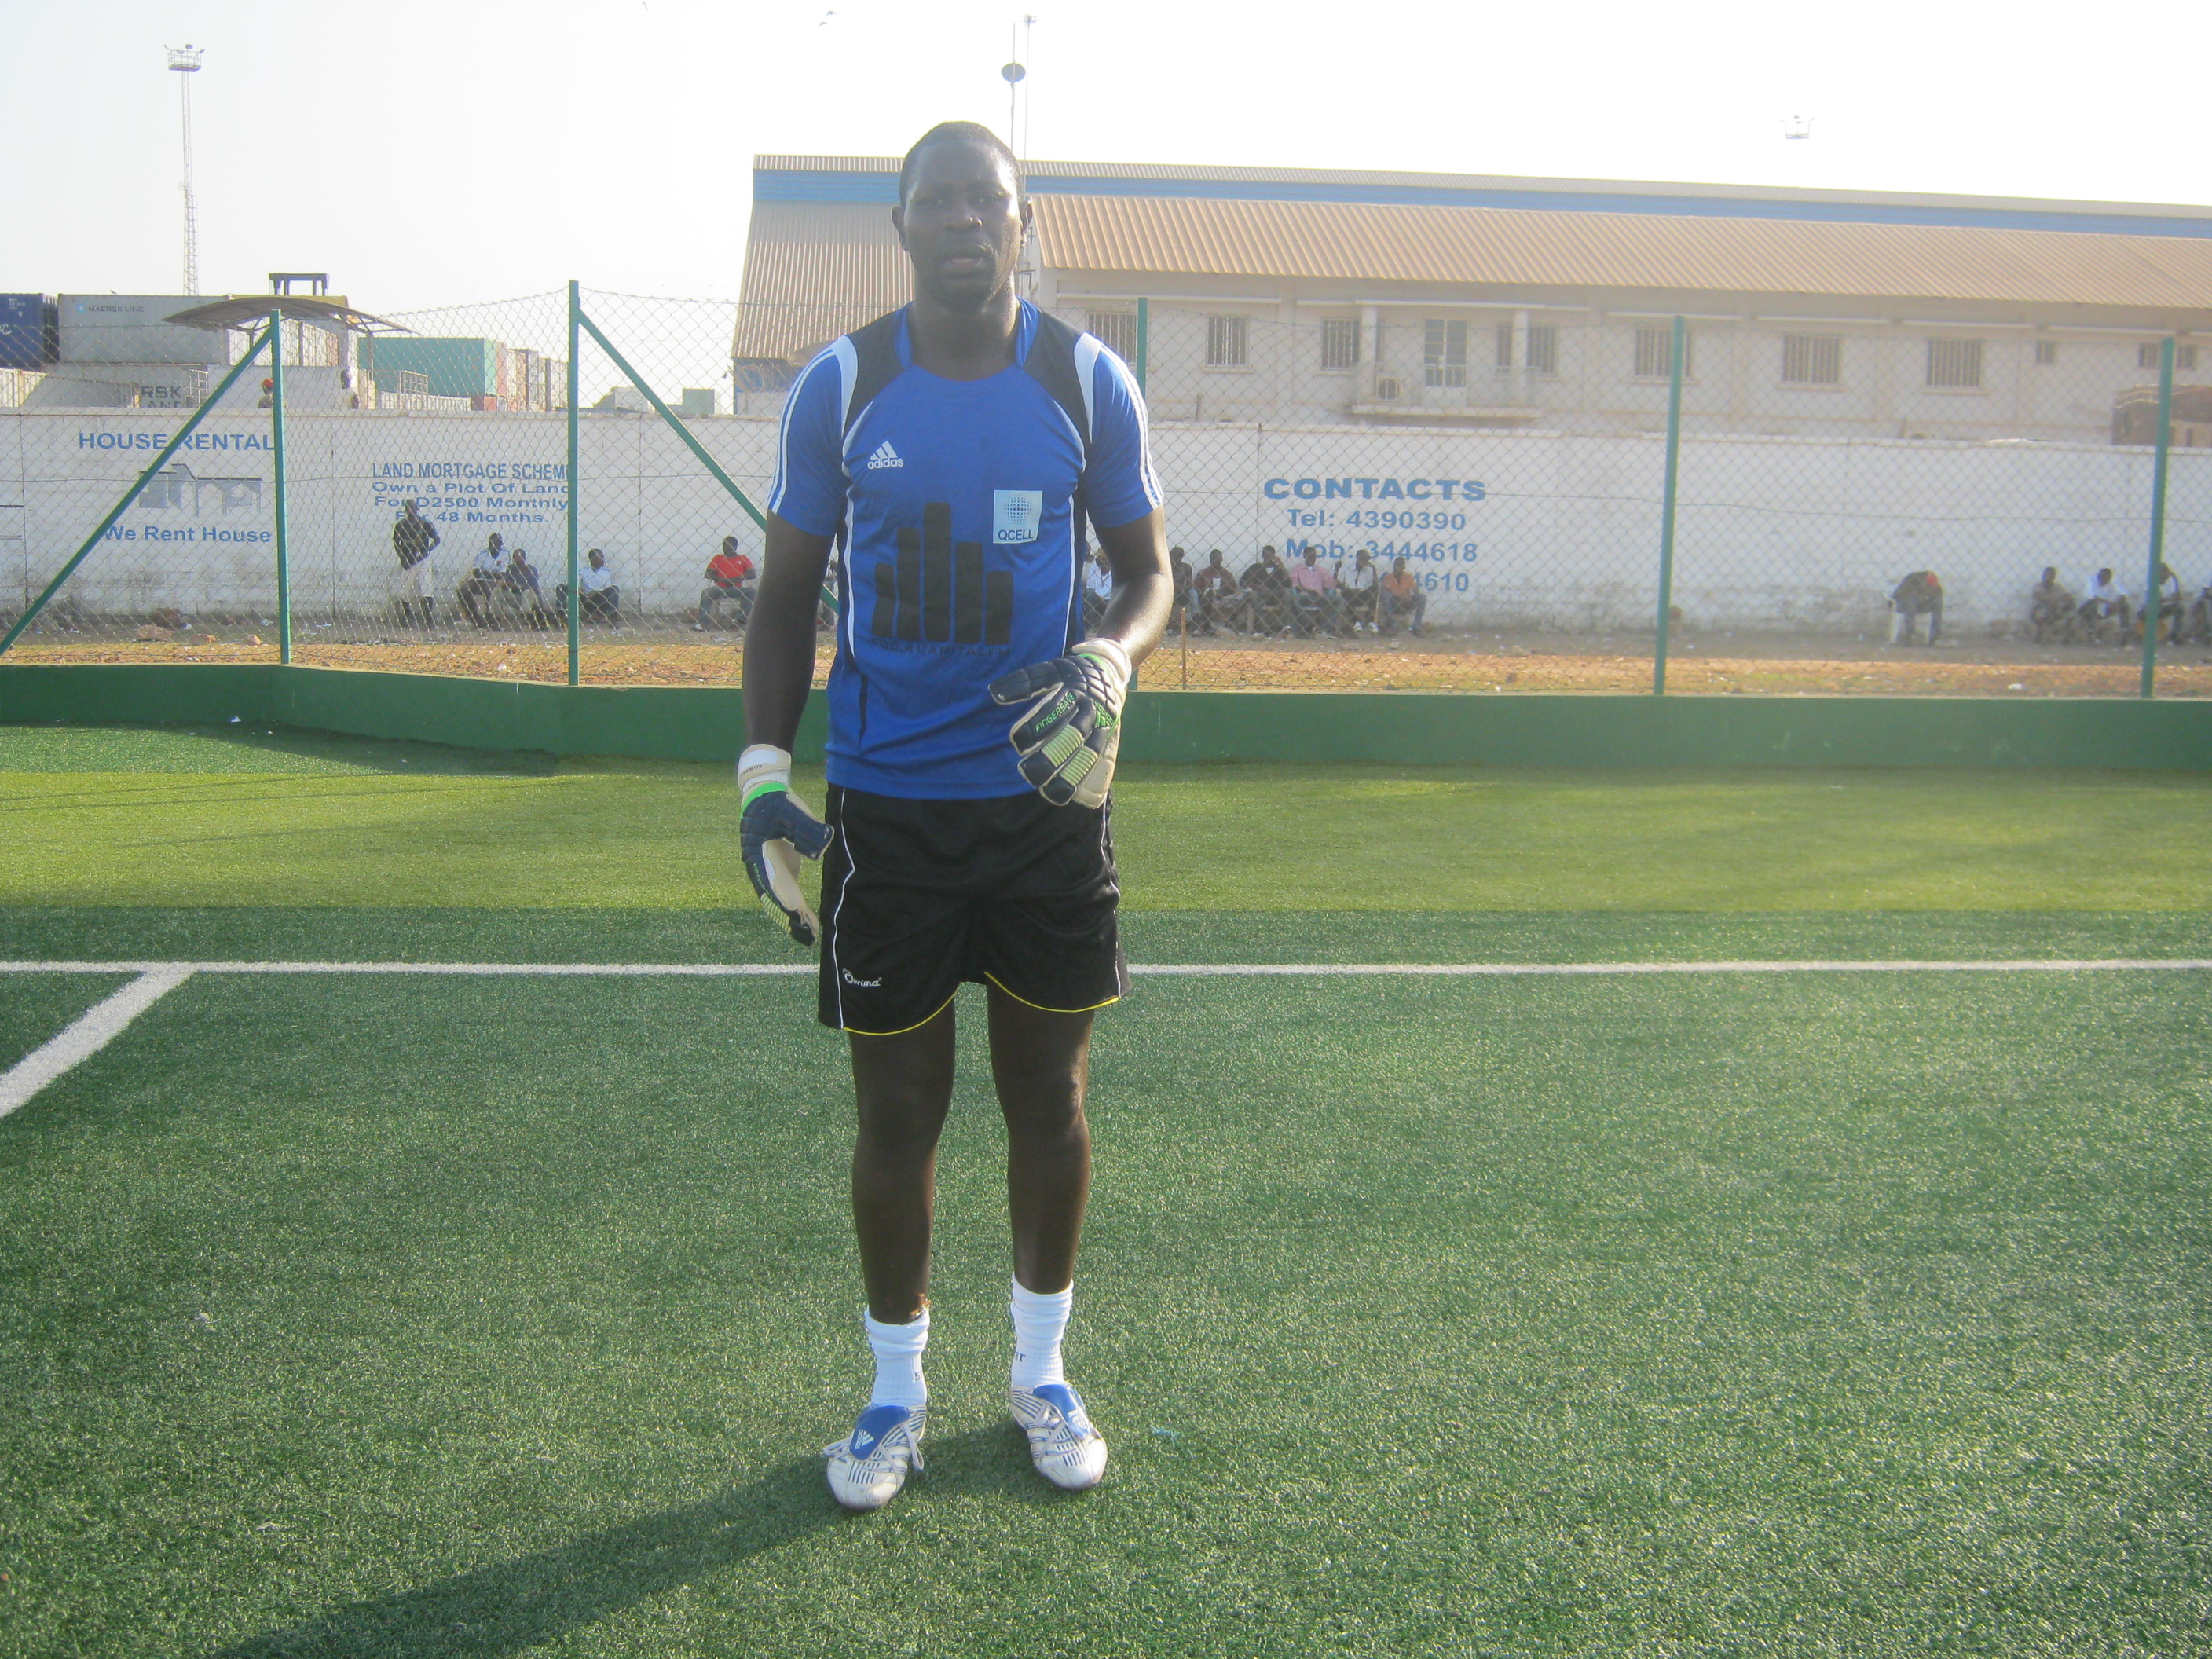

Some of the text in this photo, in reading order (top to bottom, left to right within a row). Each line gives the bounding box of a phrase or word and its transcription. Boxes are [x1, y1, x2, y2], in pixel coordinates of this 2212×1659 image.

[79, 433, 276, 450] HOUSE RENTAL
[372, 463, 568, 480] LAND MORTGAGE SCHEM
[867, 458, 904, 470] adidas
[372, 482, 419, 493] Own
[426, 484, 437, 493] a
[444, 482, 485, 493] Plot
[491, 482, 516, 493] Of
[1264, 478, 1486, 501] CONTACTS
[416, 496, 479, 508] D2500
[487, 497, 568, 511] Monthly
[436, 511, 460, 522] 48
[1287, 509, 1467, 530] Tel: 4390390
[104, 525, 272, 543] We Rent House
[998, 529, 1034, 541] QCELL
[1286, 539, 1478, 562] Mob: 3444618
[1035, 691, 1075, 733] FINGERSAVE
